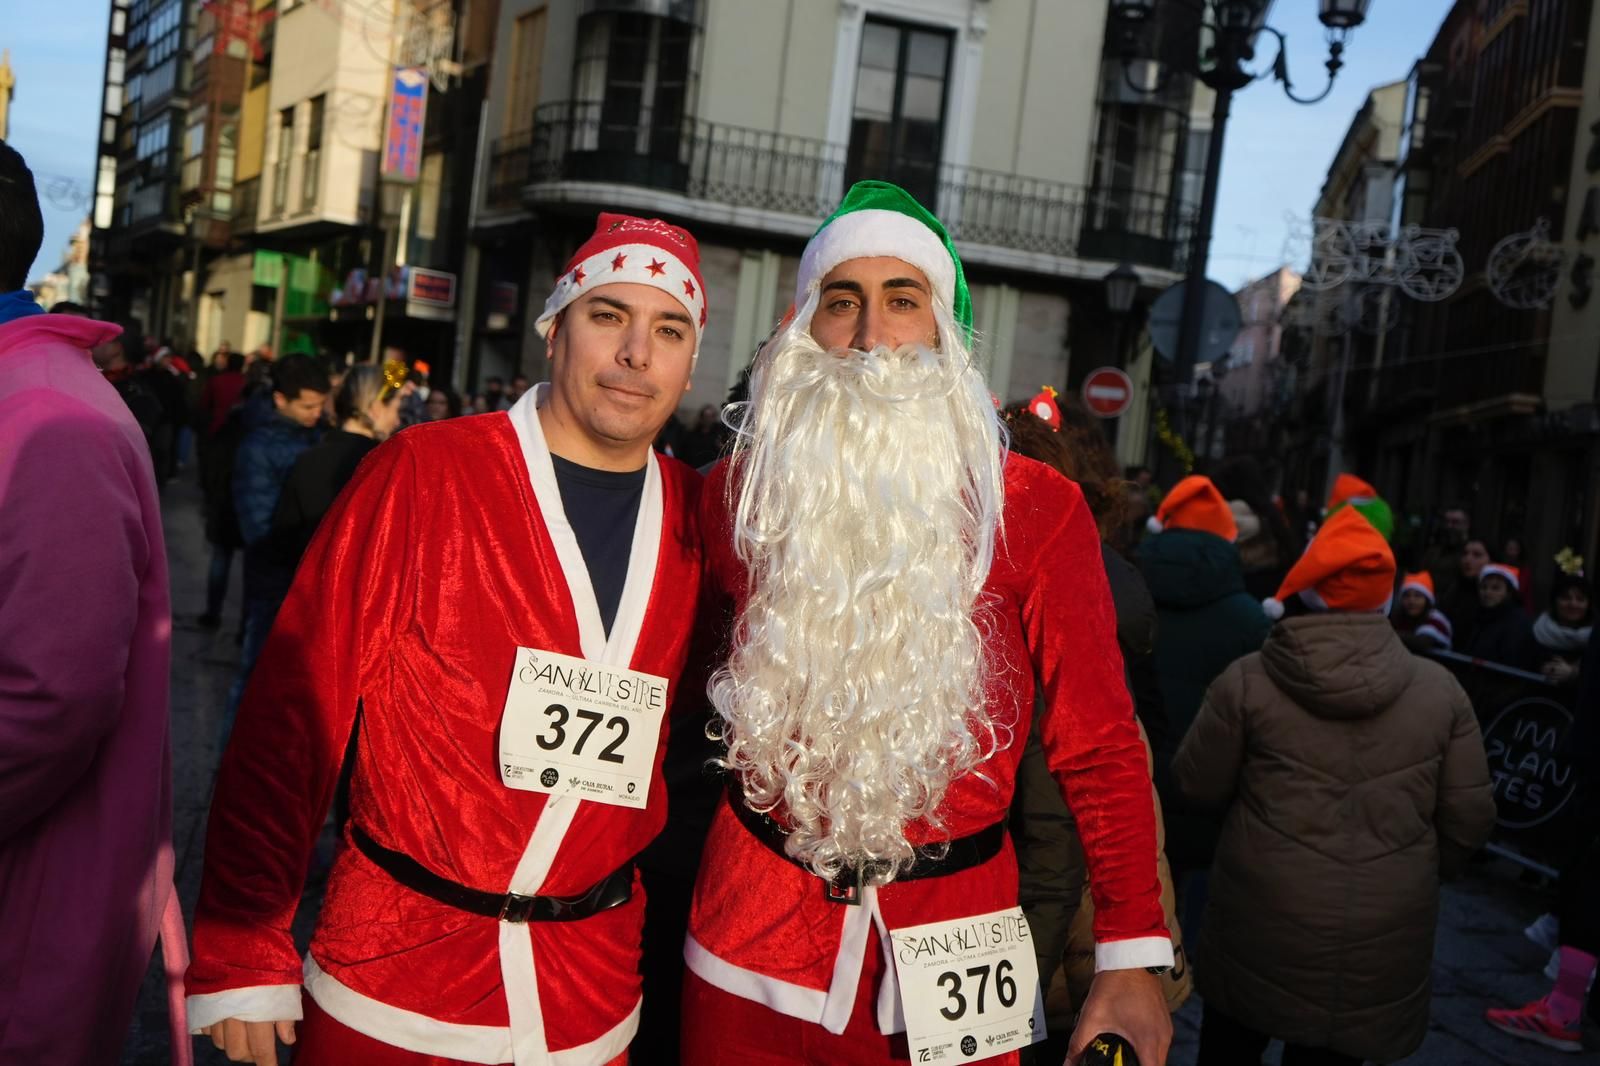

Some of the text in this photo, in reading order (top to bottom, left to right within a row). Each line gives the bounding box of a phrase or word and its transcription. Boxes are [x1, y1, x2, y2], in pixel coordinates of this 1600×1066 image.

[535, 703, 630, 764] 372
[1513, 719, 1557, 750] IM
[1493, 770, 1545, 810] TES
[936, 959, 1017, 1022] 376
